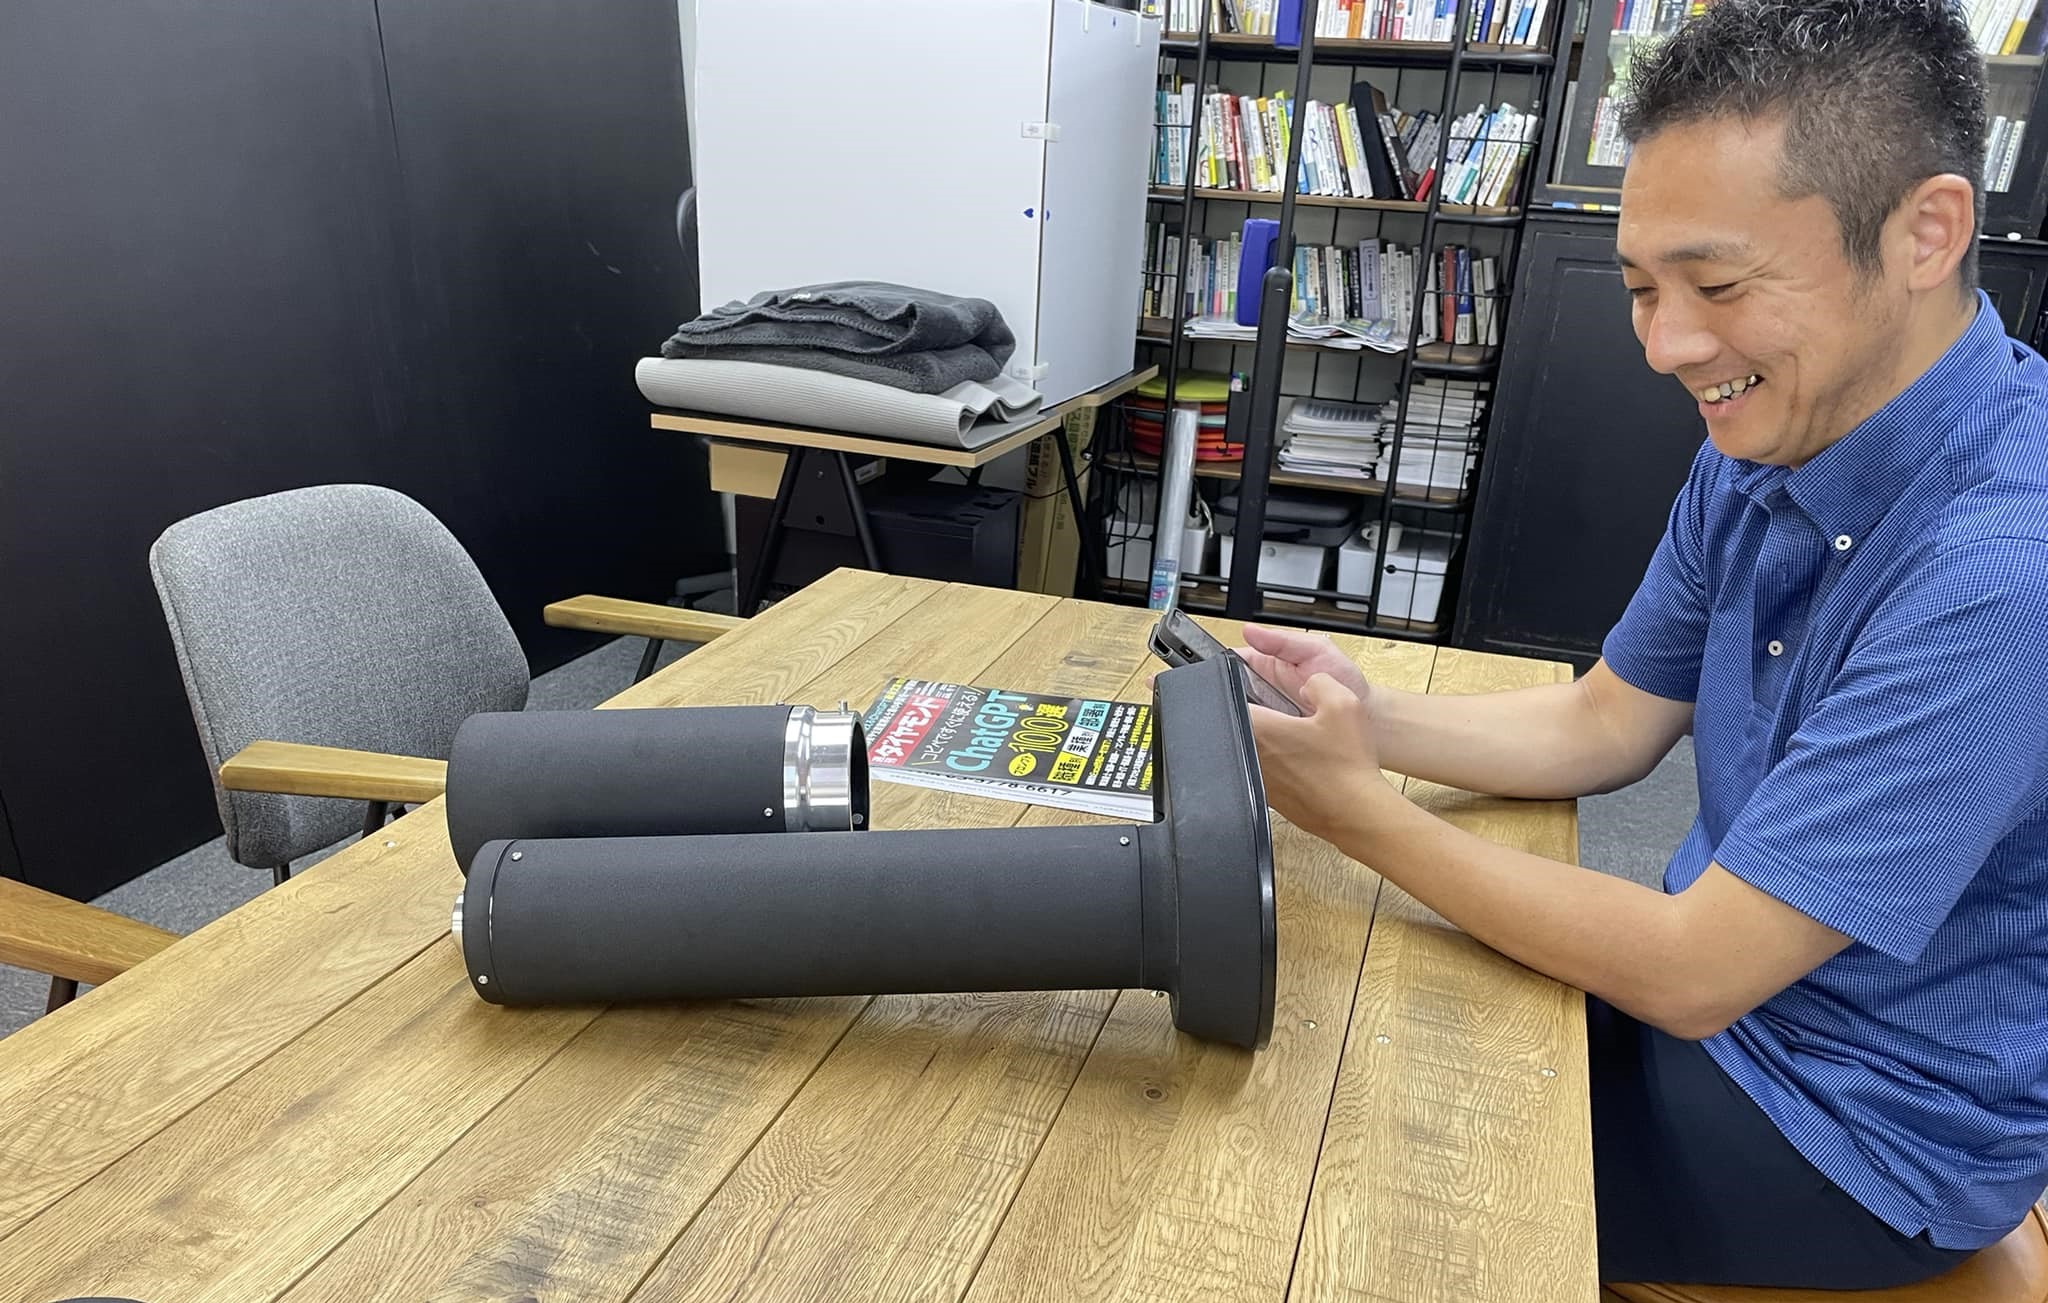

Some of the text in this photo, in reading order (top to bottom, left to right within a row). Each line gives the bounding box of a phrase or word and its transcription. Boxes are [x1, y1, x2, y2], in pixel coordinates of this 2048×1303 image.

[875, 697, 940, 757] ダイヤモンド
[920, 690, 981, 761] コピペですぐに使える!
[946, 689, 1028, 772] ChatGPT
